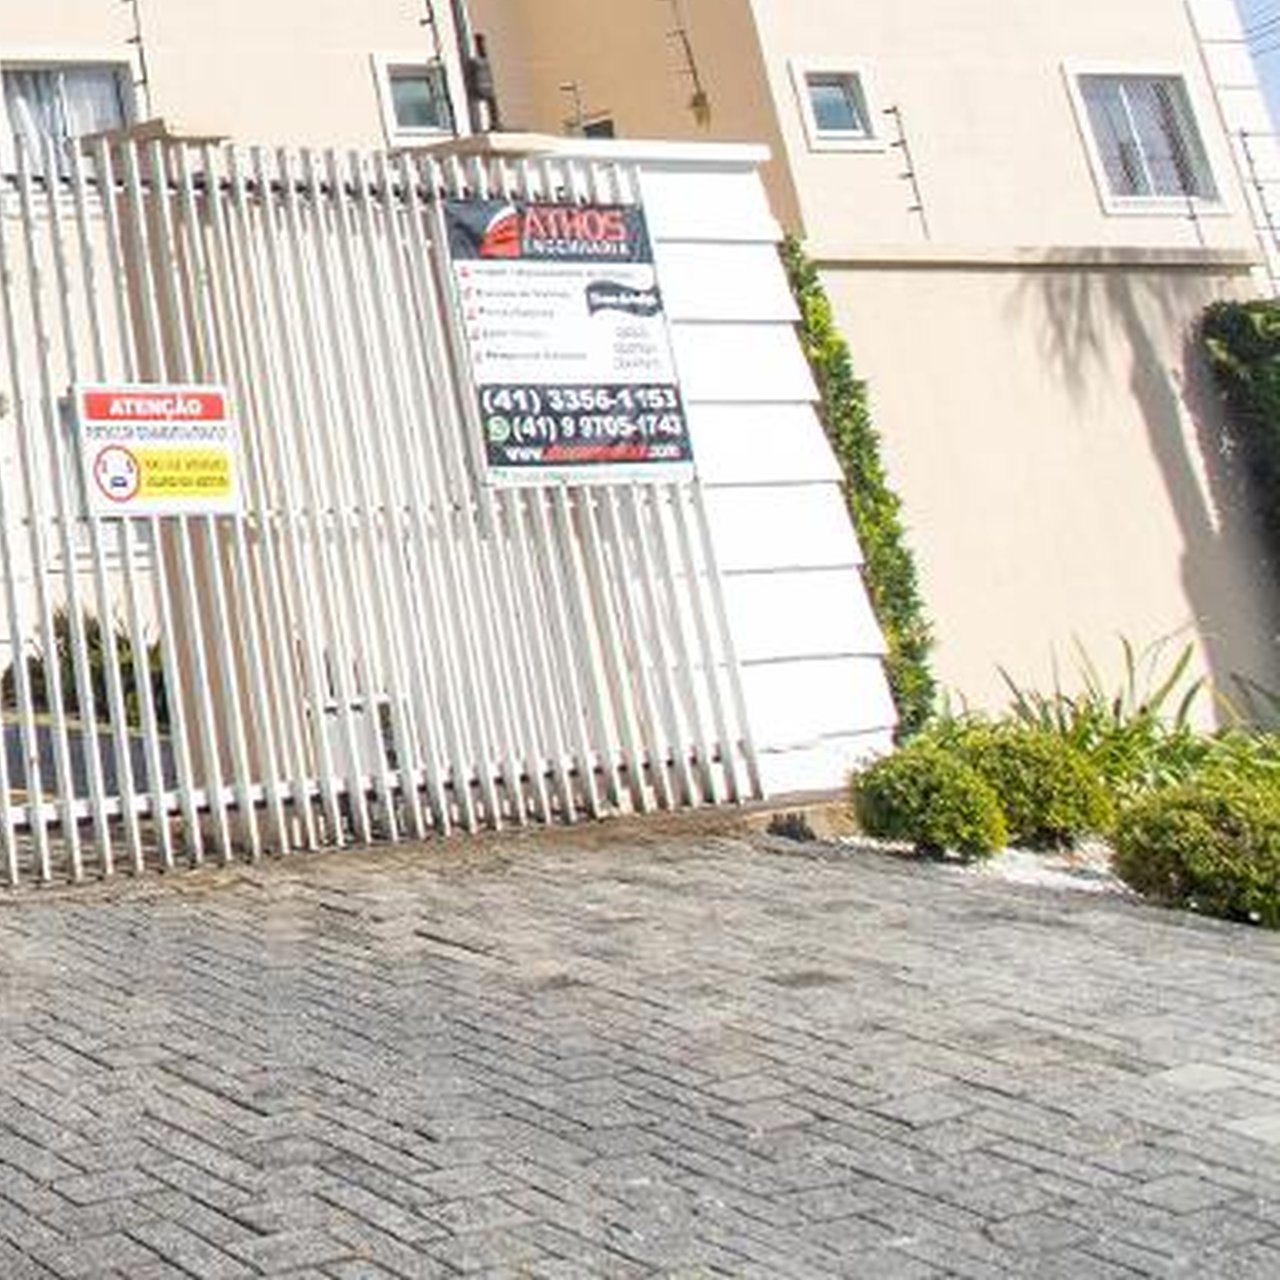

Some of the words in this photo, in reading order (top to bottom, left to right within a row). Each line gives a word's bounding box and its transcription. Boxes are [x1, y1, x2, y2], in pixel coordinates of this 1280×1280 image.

[523, 208, 628, 240] ATHOS
[109, 395, 202, 420] ATENÇÃO
[482, 389, 541, 414] (41)
[548, 388, 678, 411] 3356-1153
[513, 415, 557, 442] (41)
